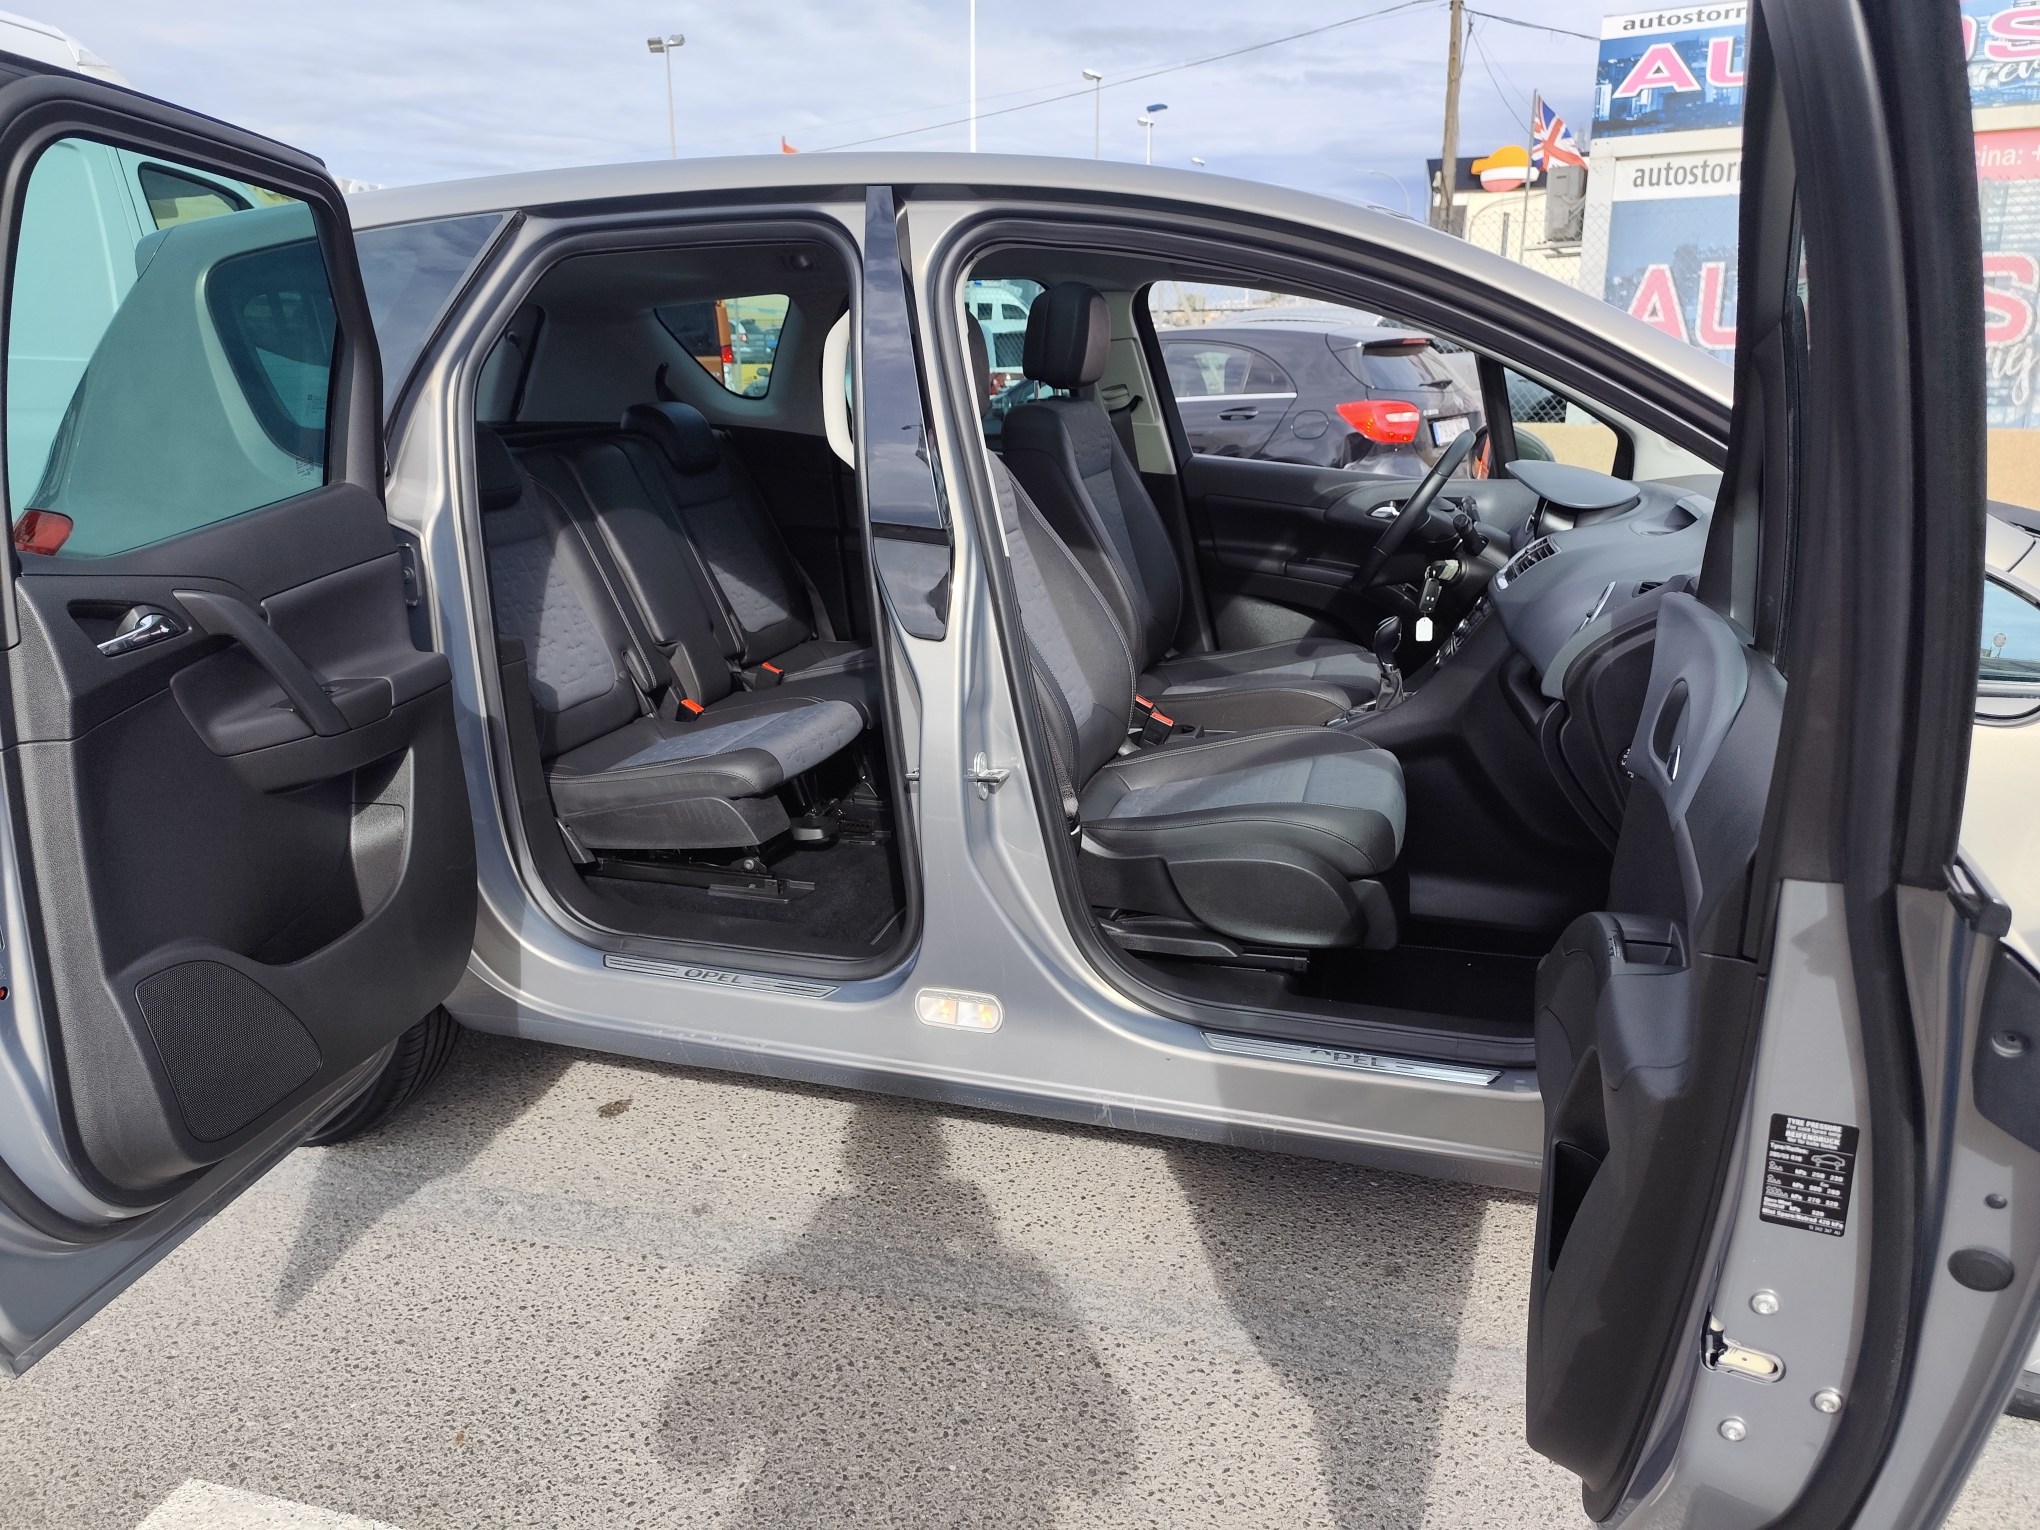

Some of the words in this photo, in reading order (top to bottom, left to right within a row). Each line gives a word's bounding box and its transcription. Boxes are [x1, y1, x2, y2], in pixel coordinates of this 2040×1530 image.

[1622, 6, 1746, 31] autostorr
[1633, 159, 1741, 188] autostor
[684, 968, 742, 984] OPEL
[1310, 1049, 1386, 1068] OPEL
[1787, 1117, 1805, 1127] TYRE
[1805, 1120, 1843, 1133] PRESSURE
[1785, 1130, 1841, 1146] REIFENDRUCK
